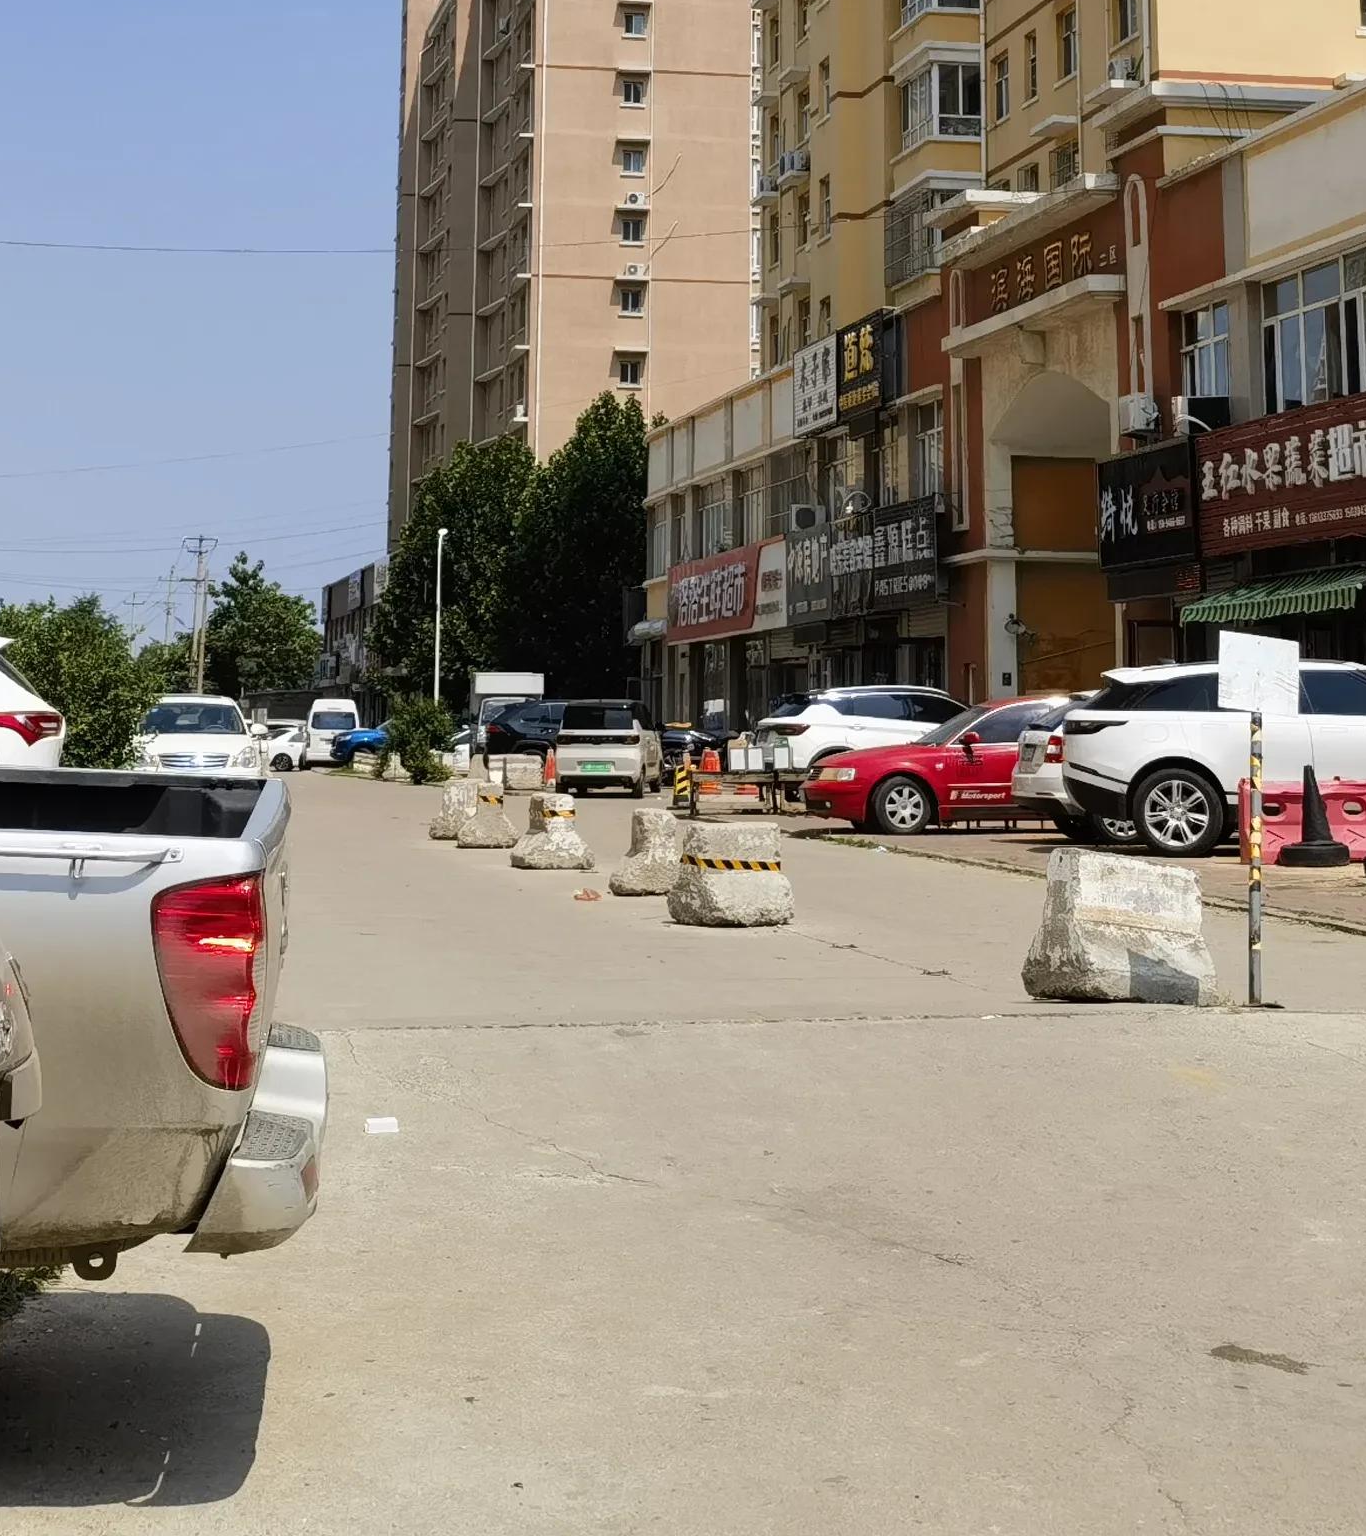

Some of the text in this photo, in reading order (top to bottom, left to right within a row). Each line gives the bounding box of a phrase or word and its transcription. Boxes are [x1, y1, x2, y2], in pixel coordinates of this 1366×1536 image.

[990, 231, 1093, 312] 滨海国际
[961, 792, 1006, 801] Motorsport
